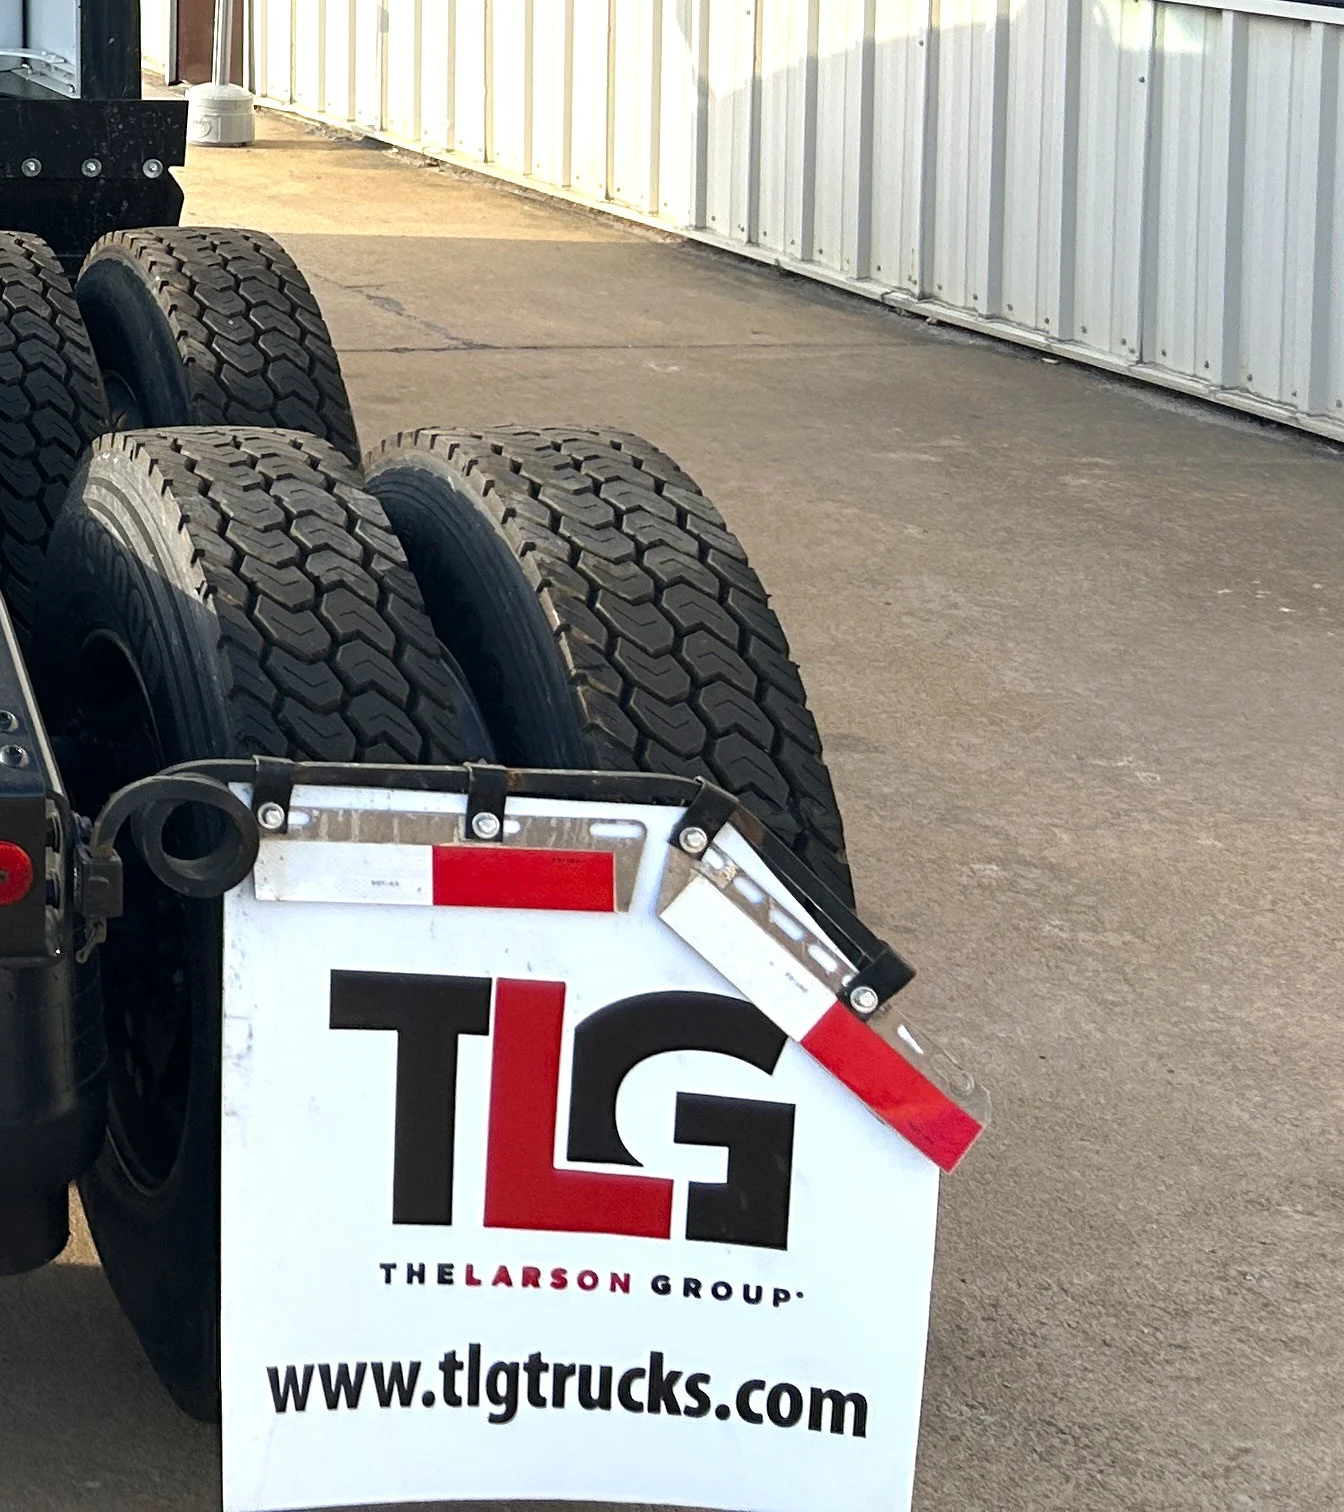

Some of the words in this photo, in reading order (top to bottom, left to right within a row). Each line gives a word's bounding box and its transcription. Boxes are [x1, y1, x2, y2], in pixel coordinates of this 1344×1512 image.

[328, 968, 797, 1251] TLG
[650, 1273, 795, 1308] GROUP
[266, 1343, 869, 1439] www.tlgtrucks.com
